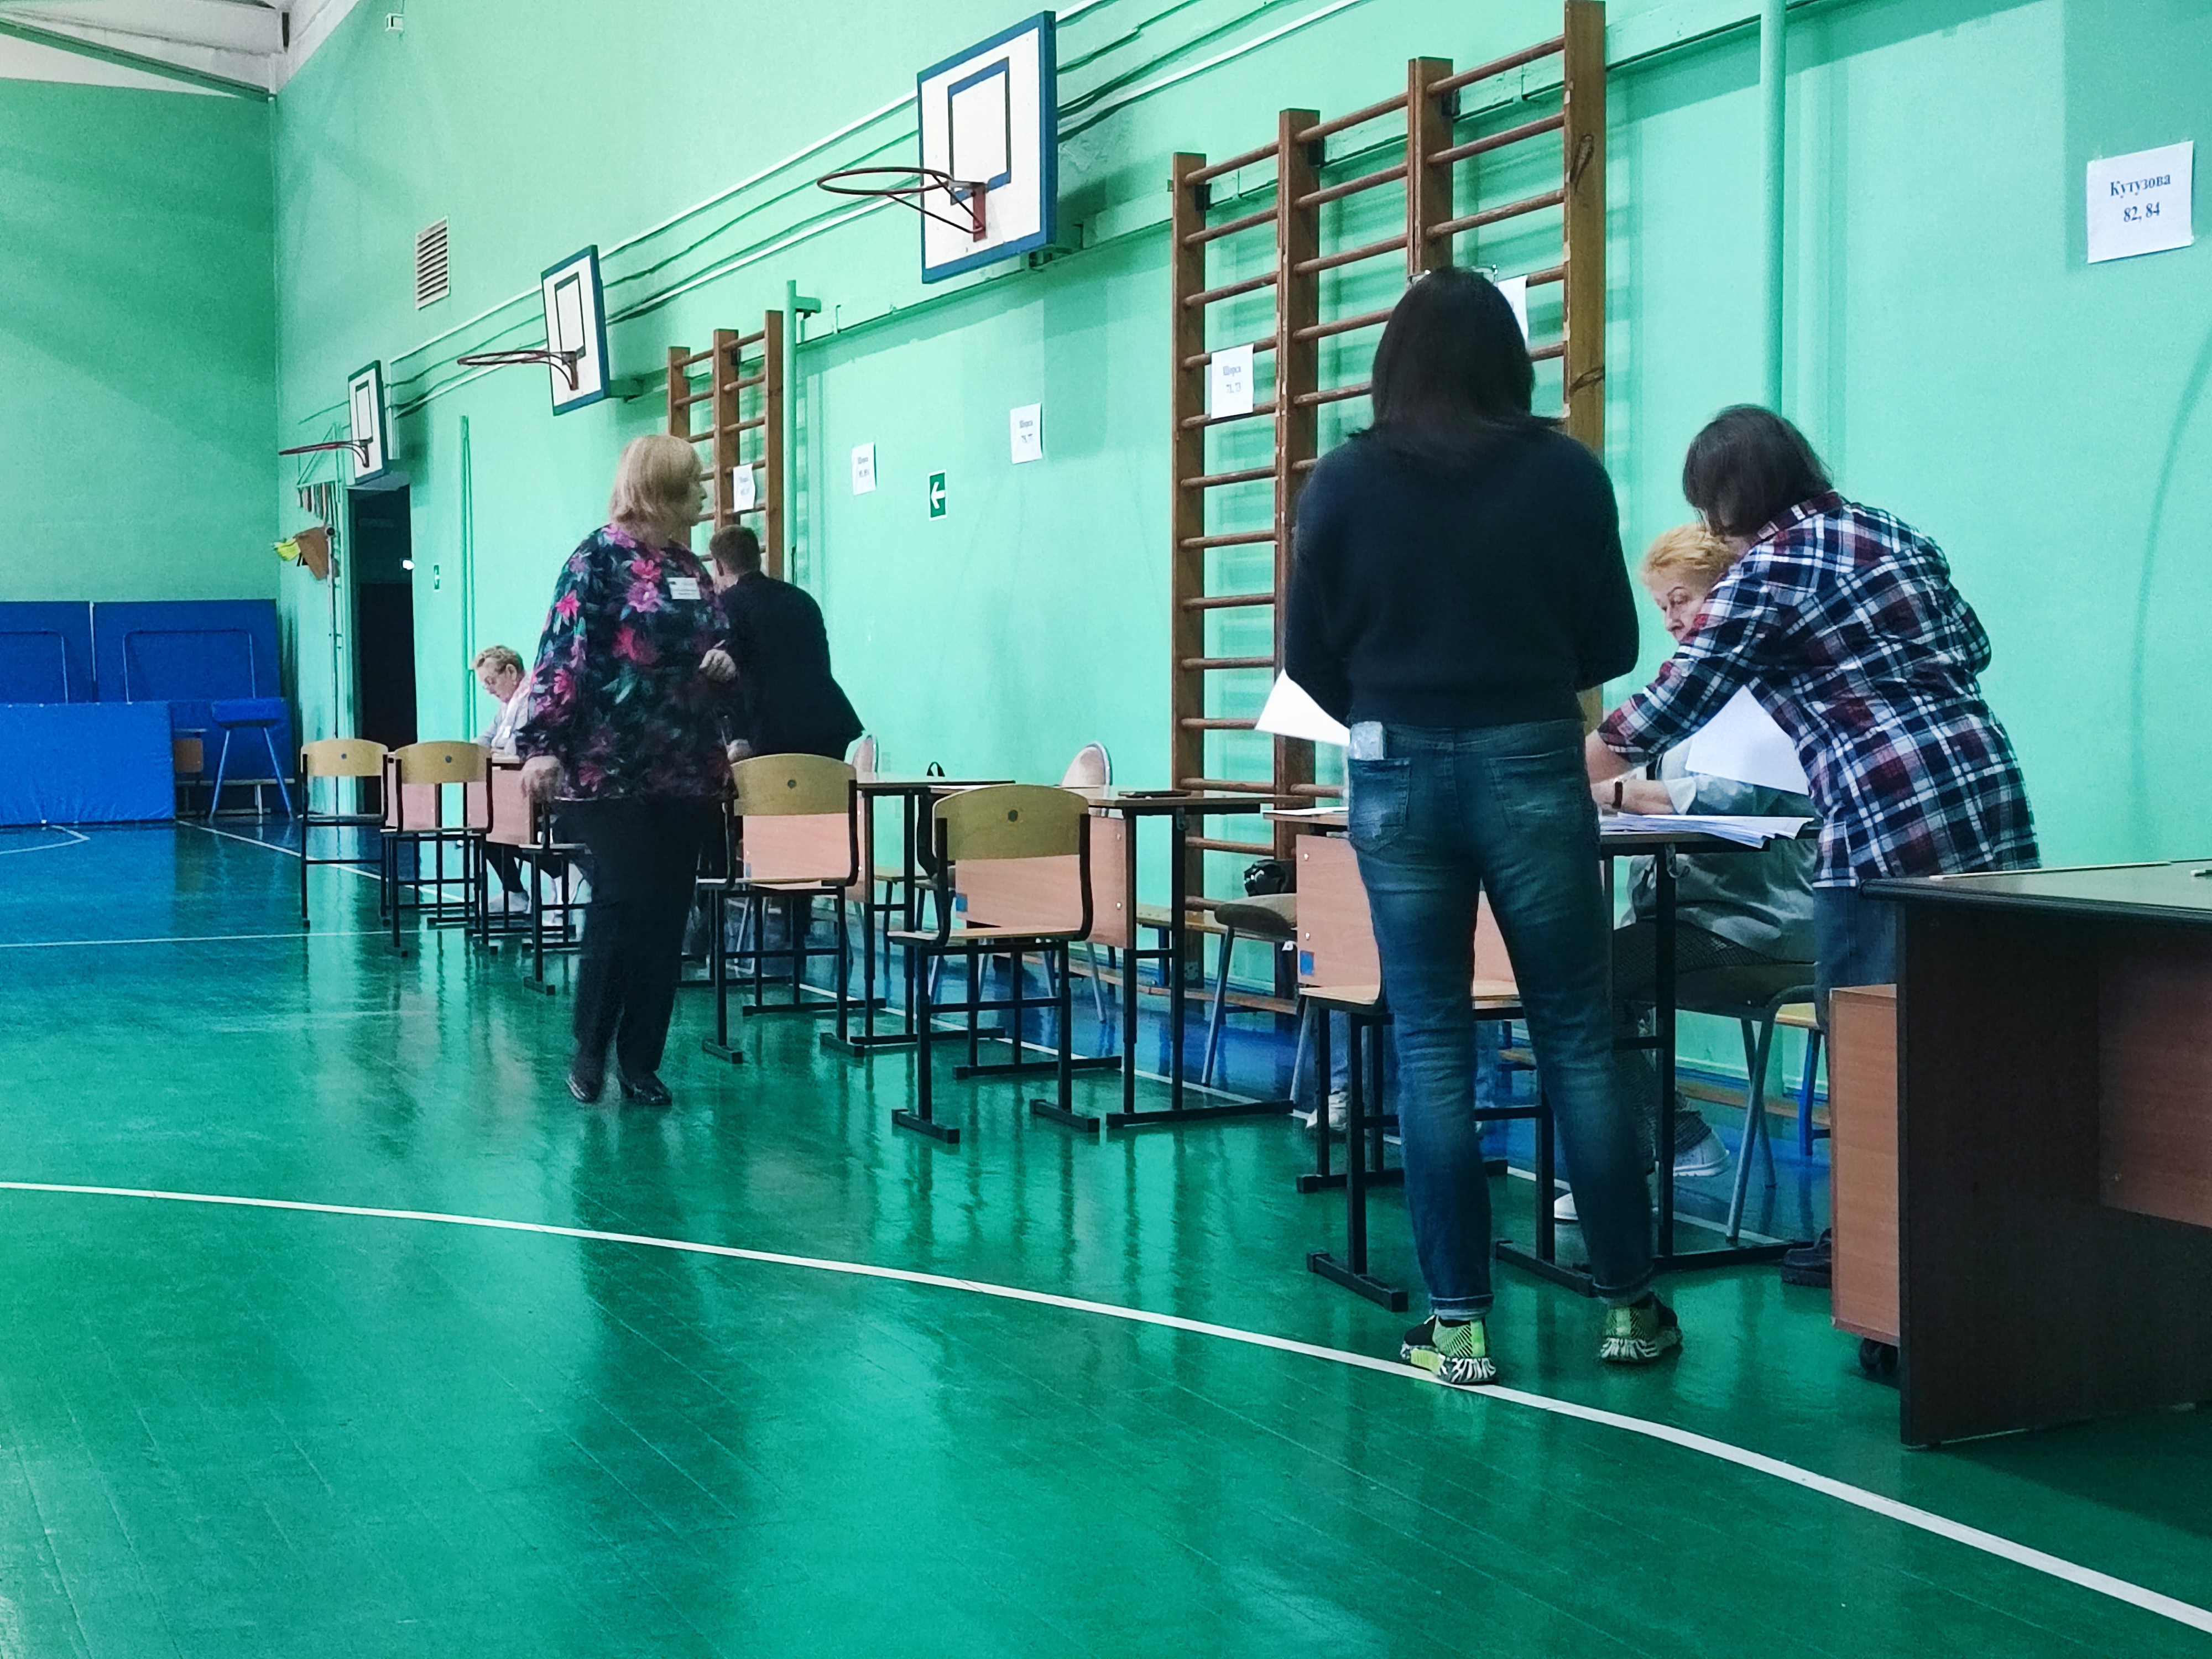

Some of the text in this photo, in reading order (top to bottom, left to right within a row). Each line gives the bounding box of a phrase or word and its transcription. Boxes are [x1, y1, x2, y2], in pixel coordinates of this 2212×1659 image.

[2110, 174, 2171, 199] Кутузова
[2123, 201, 2161, 223] 82, 84
